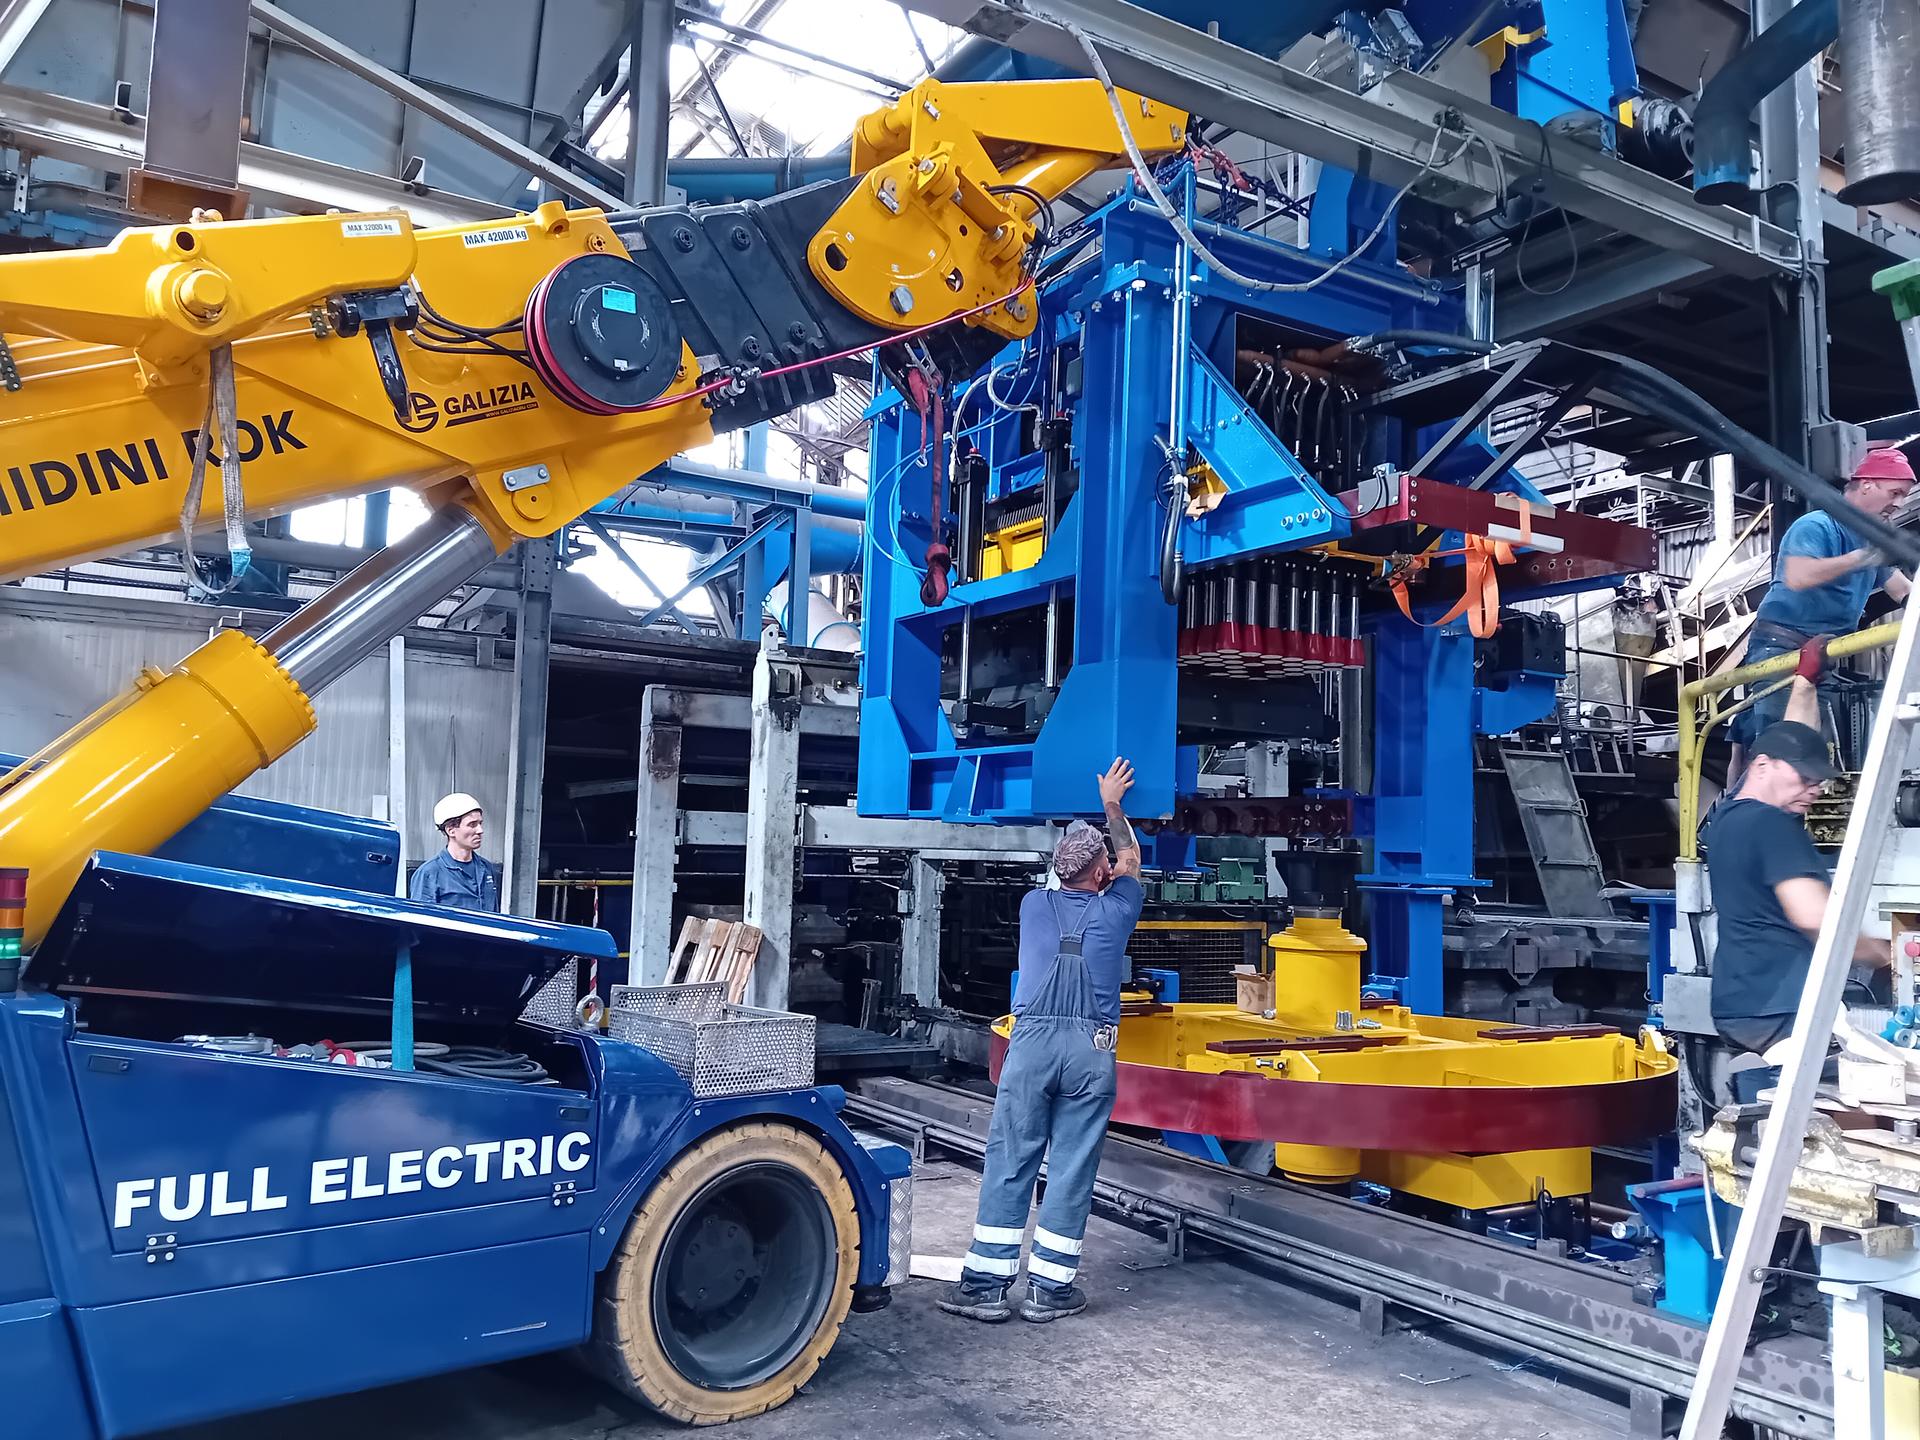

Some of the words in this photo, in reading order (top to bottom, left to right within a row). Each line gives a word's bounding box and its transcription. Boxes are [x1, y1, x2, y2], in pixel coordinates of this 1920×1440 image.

[364, 223, 383, 231] 32000
[384, 223, 393, 232] kg
[464, 233, 487, 246] MAX
[488, 229, 515, 242] 42000
[516, 229, 527, 240] kg
[443, 381, 536, 415] GALIZIA
[181, 410, 308, 467] ROK
[113, 1166, 288, 1229] FULL
[310, 1131, 592, 1204] ELECTRIC
